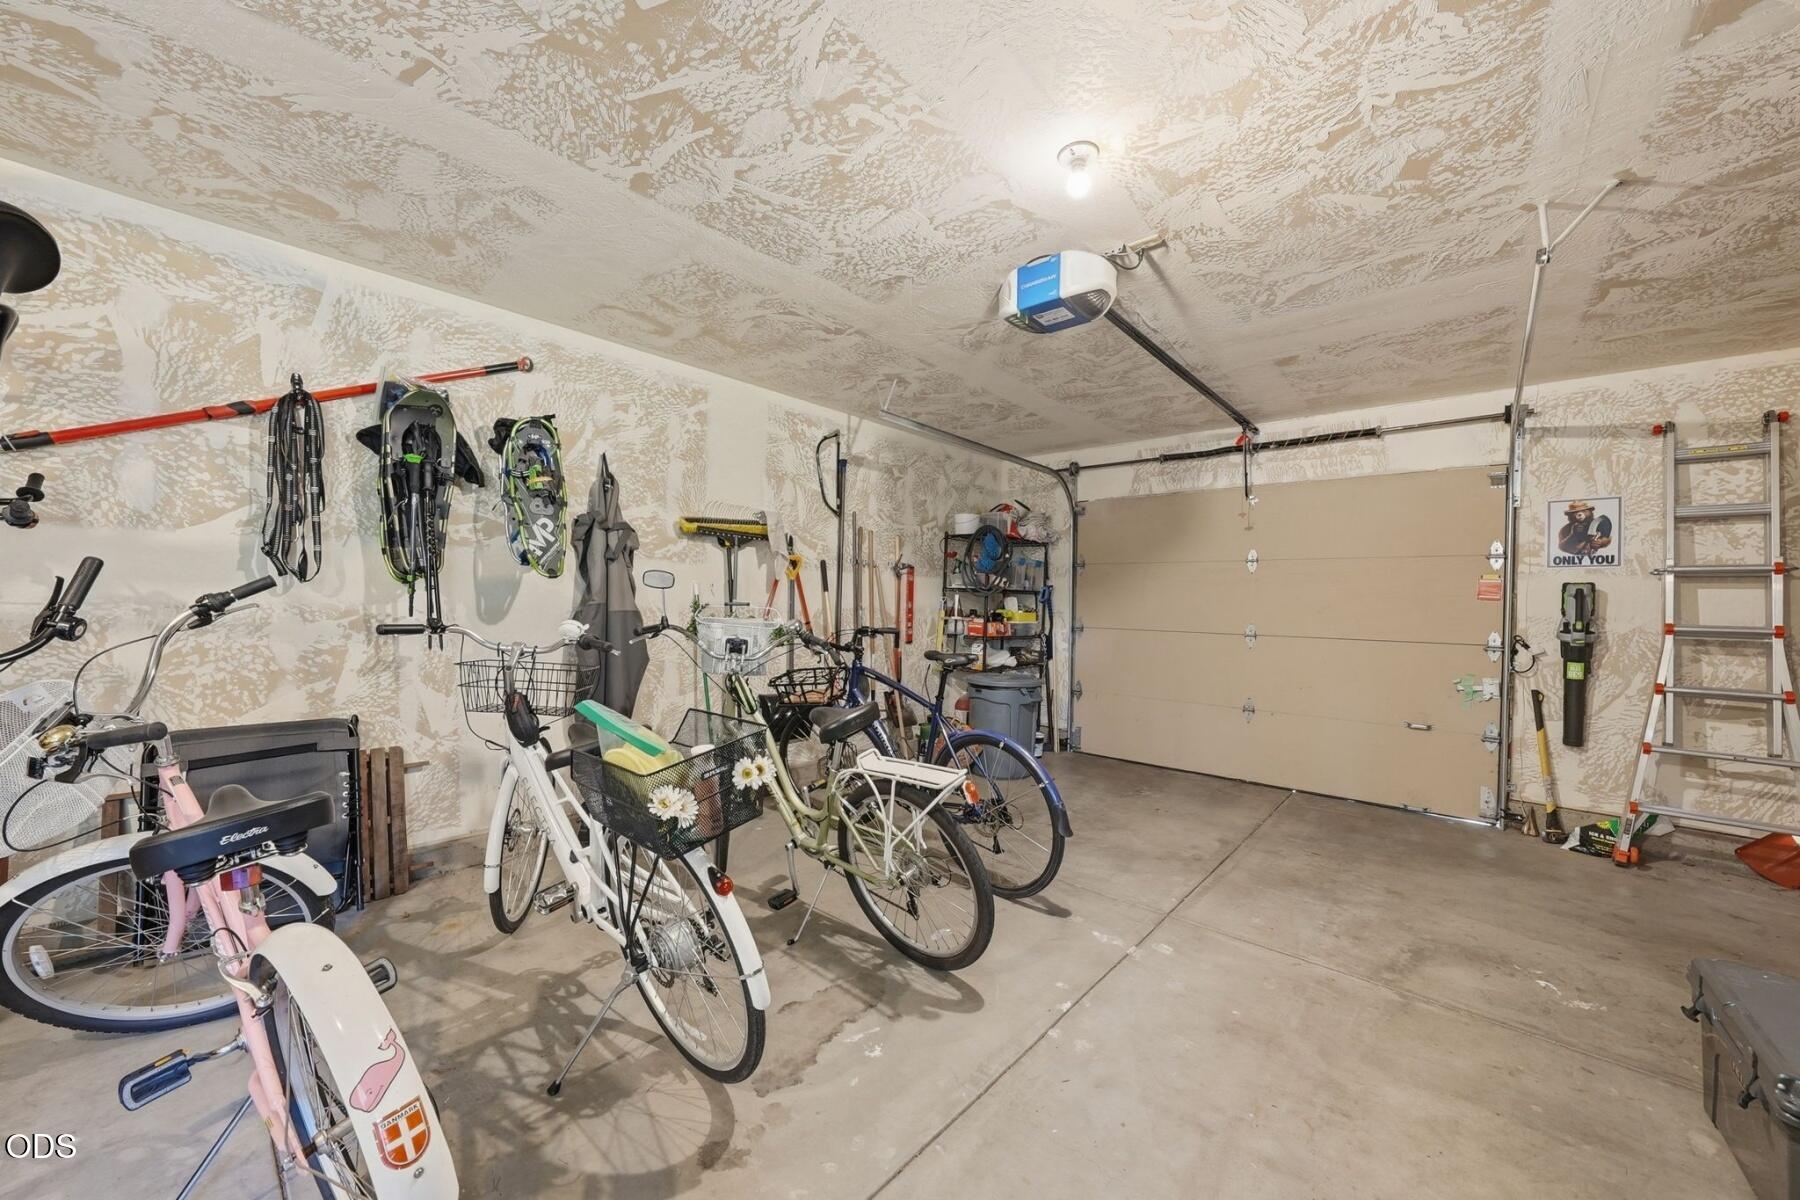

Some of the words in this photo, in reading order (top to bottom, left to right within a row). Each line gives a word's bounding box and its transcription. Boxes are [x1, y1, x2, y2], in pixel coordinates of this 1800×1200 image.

[1552, 555, 1585, 566] ONLY
[1588, 554, 1615, 565] YOU
[219, 825, 270, 846] Electra
[380, 1103, 419, 1129] DANMARK
